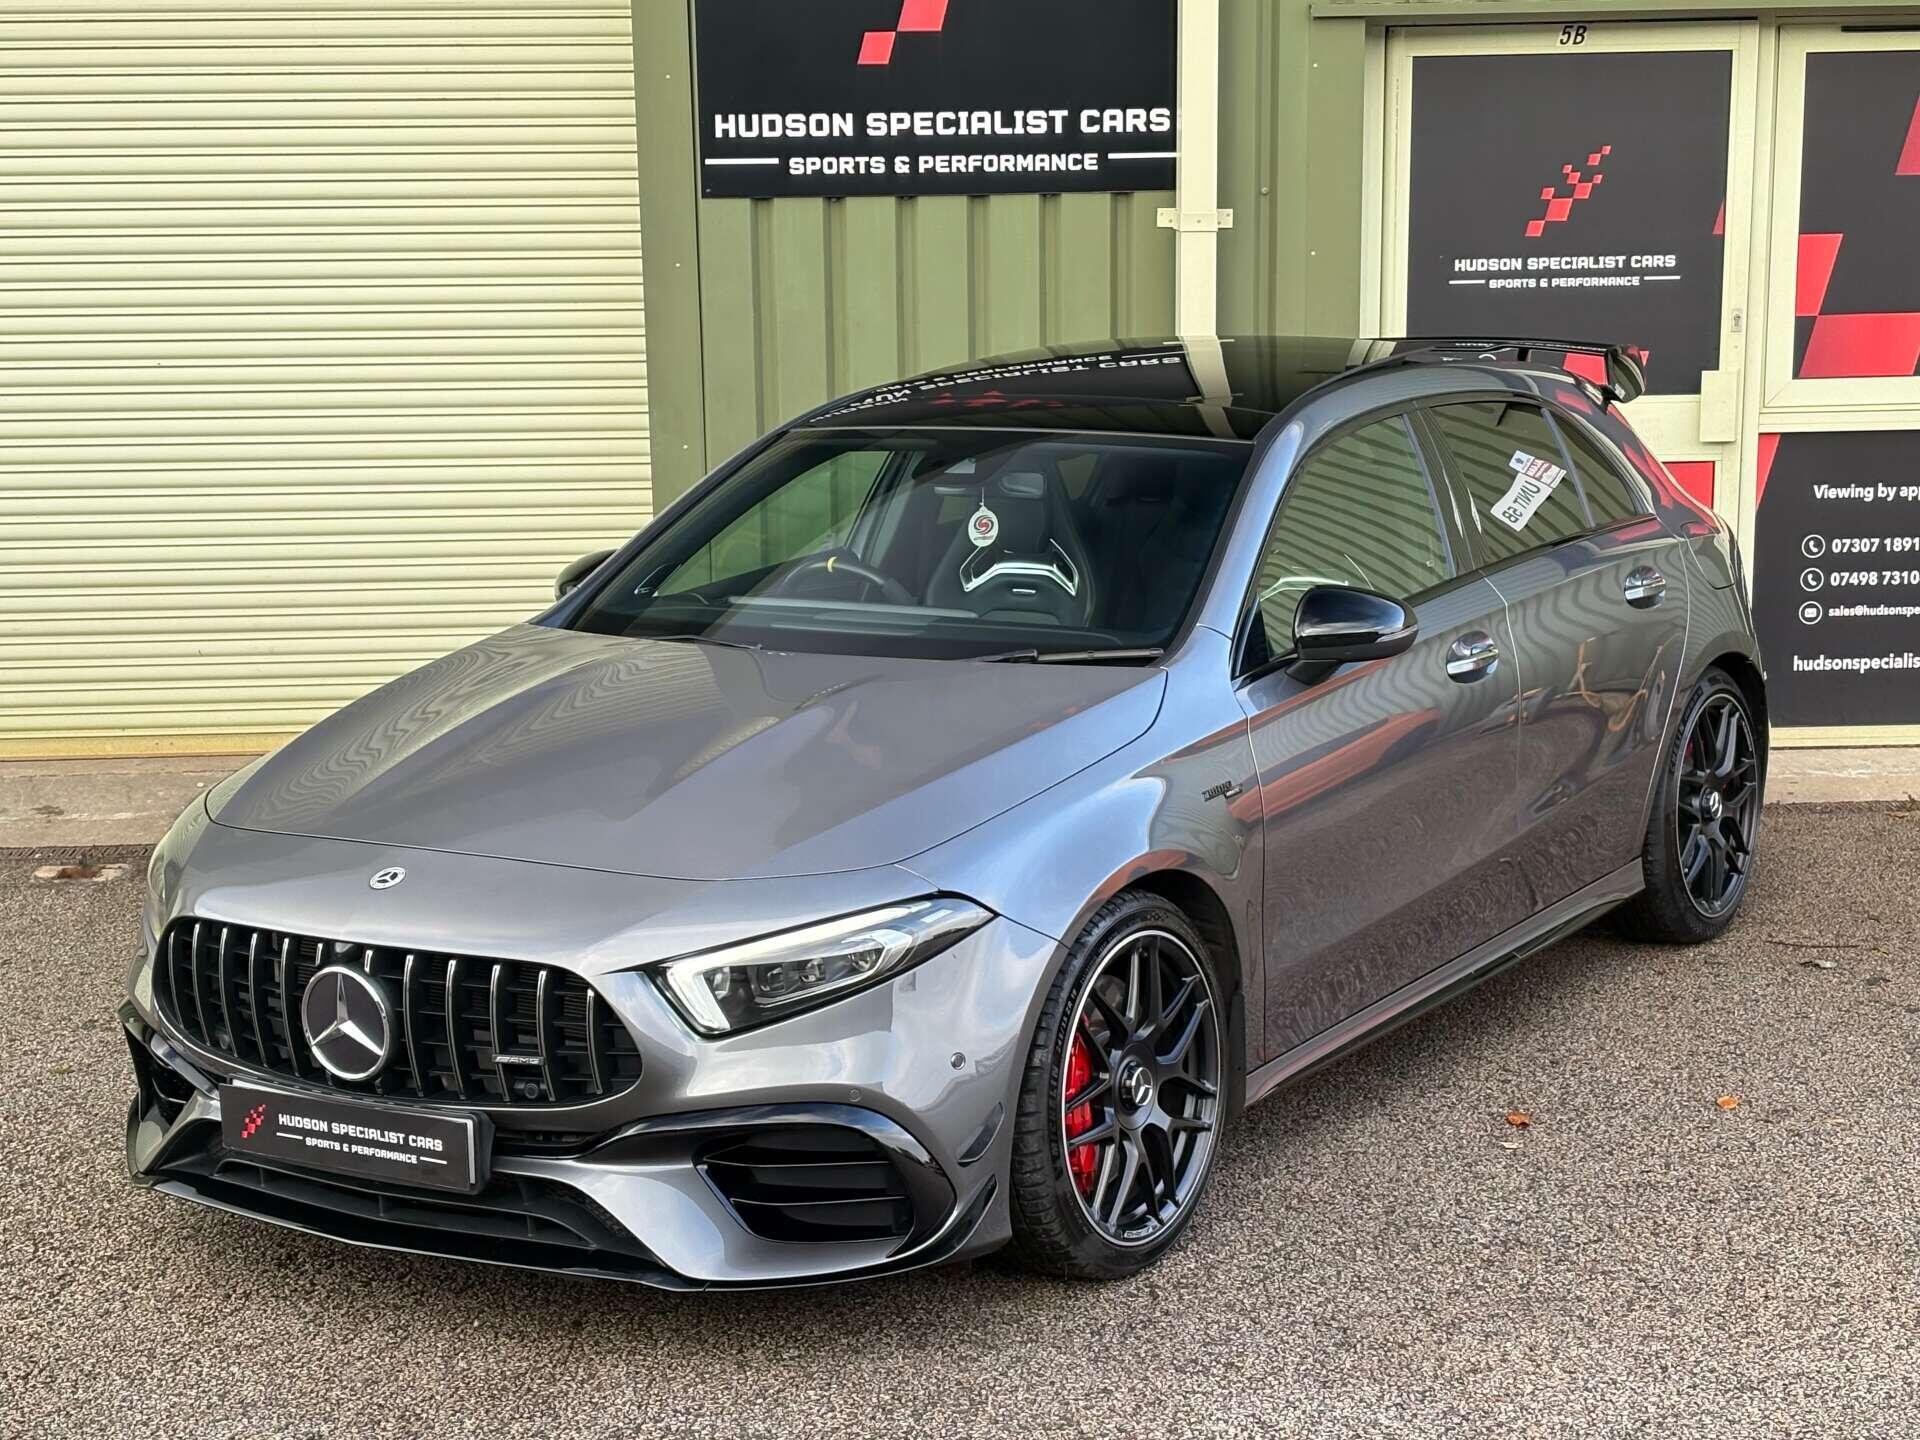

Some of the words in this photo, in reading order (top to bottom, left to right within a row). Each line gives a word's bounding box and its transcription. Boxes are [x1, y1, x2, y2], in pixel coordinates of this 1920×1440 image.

[1560, 25, 1587, 45] 5B
[714, 112, 854, 138] HUDSON
[866, 109, 1069, 137] SPECIALIST
[1080, 107, 1171, 134] CARS
[788, 156, 886, 175] SPORTS
[894, 155, 910, 174] &
[918, 152, 1099, 174] PERFORMANCE
[1454, 257, 1523, 272] HUDSON
[1527, 255, 1626, 270] SPECIALIST
[1630, 254, 1676, 268] CARS
[1488, 278, 1537, 289] SPORTS
[1539, 278, 1548, 288] &
[1551, 275, 1641, 288] PERFORMANCE
[1813, 483, 1874, 501] Viewing
[1877, 482, 1897, 502] by
[1899, 484, 1920, 501] ap
[1831, 537, 1880, 554] 07307
[1883, 536, 1920, 552] 1891
[1830, 571, 1878, 587] 07498
[1882, 570, 1920, 586] 7310
[1793, 652, 1920, 674] hudsonspecialis
[278, 1113, 328, 1133] HUDSON
[331, 1123, 405, 1146] SPECIALIST
[408, 1134, 443, 1151] CARS
[305, 1137, 341, 1151] SPORTS
[342, 1143, 350, 1153] &
[351, 1143, 418, 1164] PERFORMANCE
